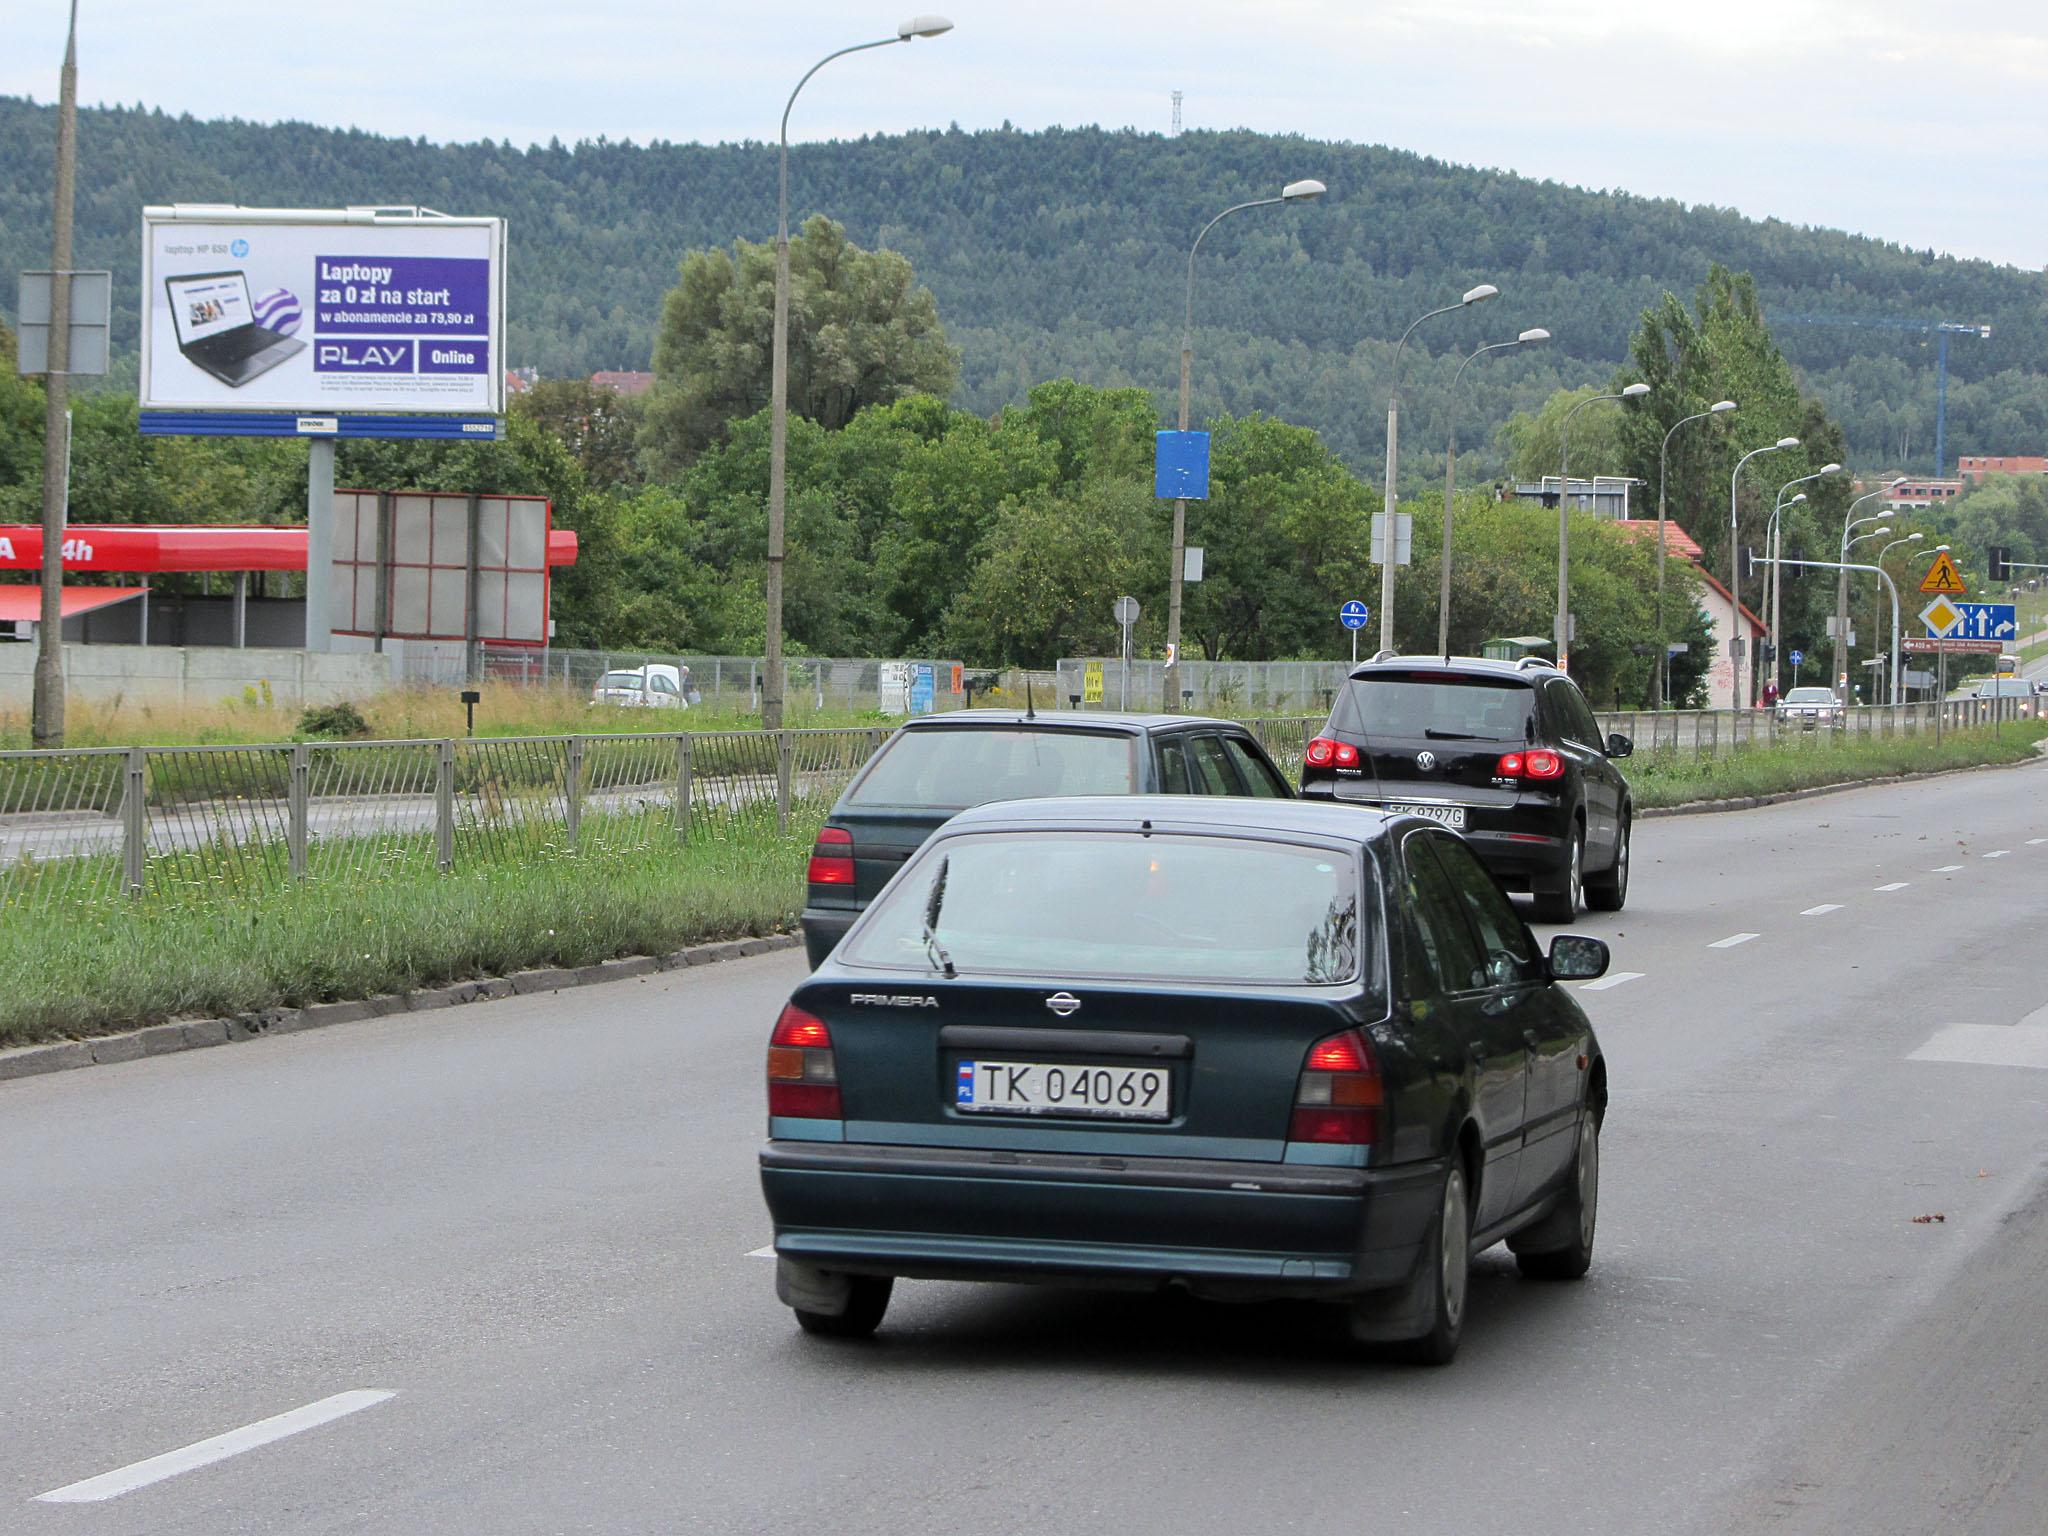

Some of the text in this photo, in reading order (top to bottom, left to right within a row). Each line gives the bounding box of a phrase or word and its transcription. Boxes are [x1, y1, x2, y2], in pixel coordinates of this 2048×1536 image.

[165, 245, 194, 256] laptop
[197, 245, 209, 253] HP
[321, 263, 392, 283] Laptopy
[320, 286, 450, 306] za 0 zł na start
[320, 311, 474, 326] w abonamencie za 79,90 zł
[320, 346, 406, 366] PLAY
[432, 350, 475, 365] Online
[850, 993, 939, 1008] PRIMERA
[958, 1086, 972, 1097] PL
[982, 1065, 1160, 1107] TK 04069
